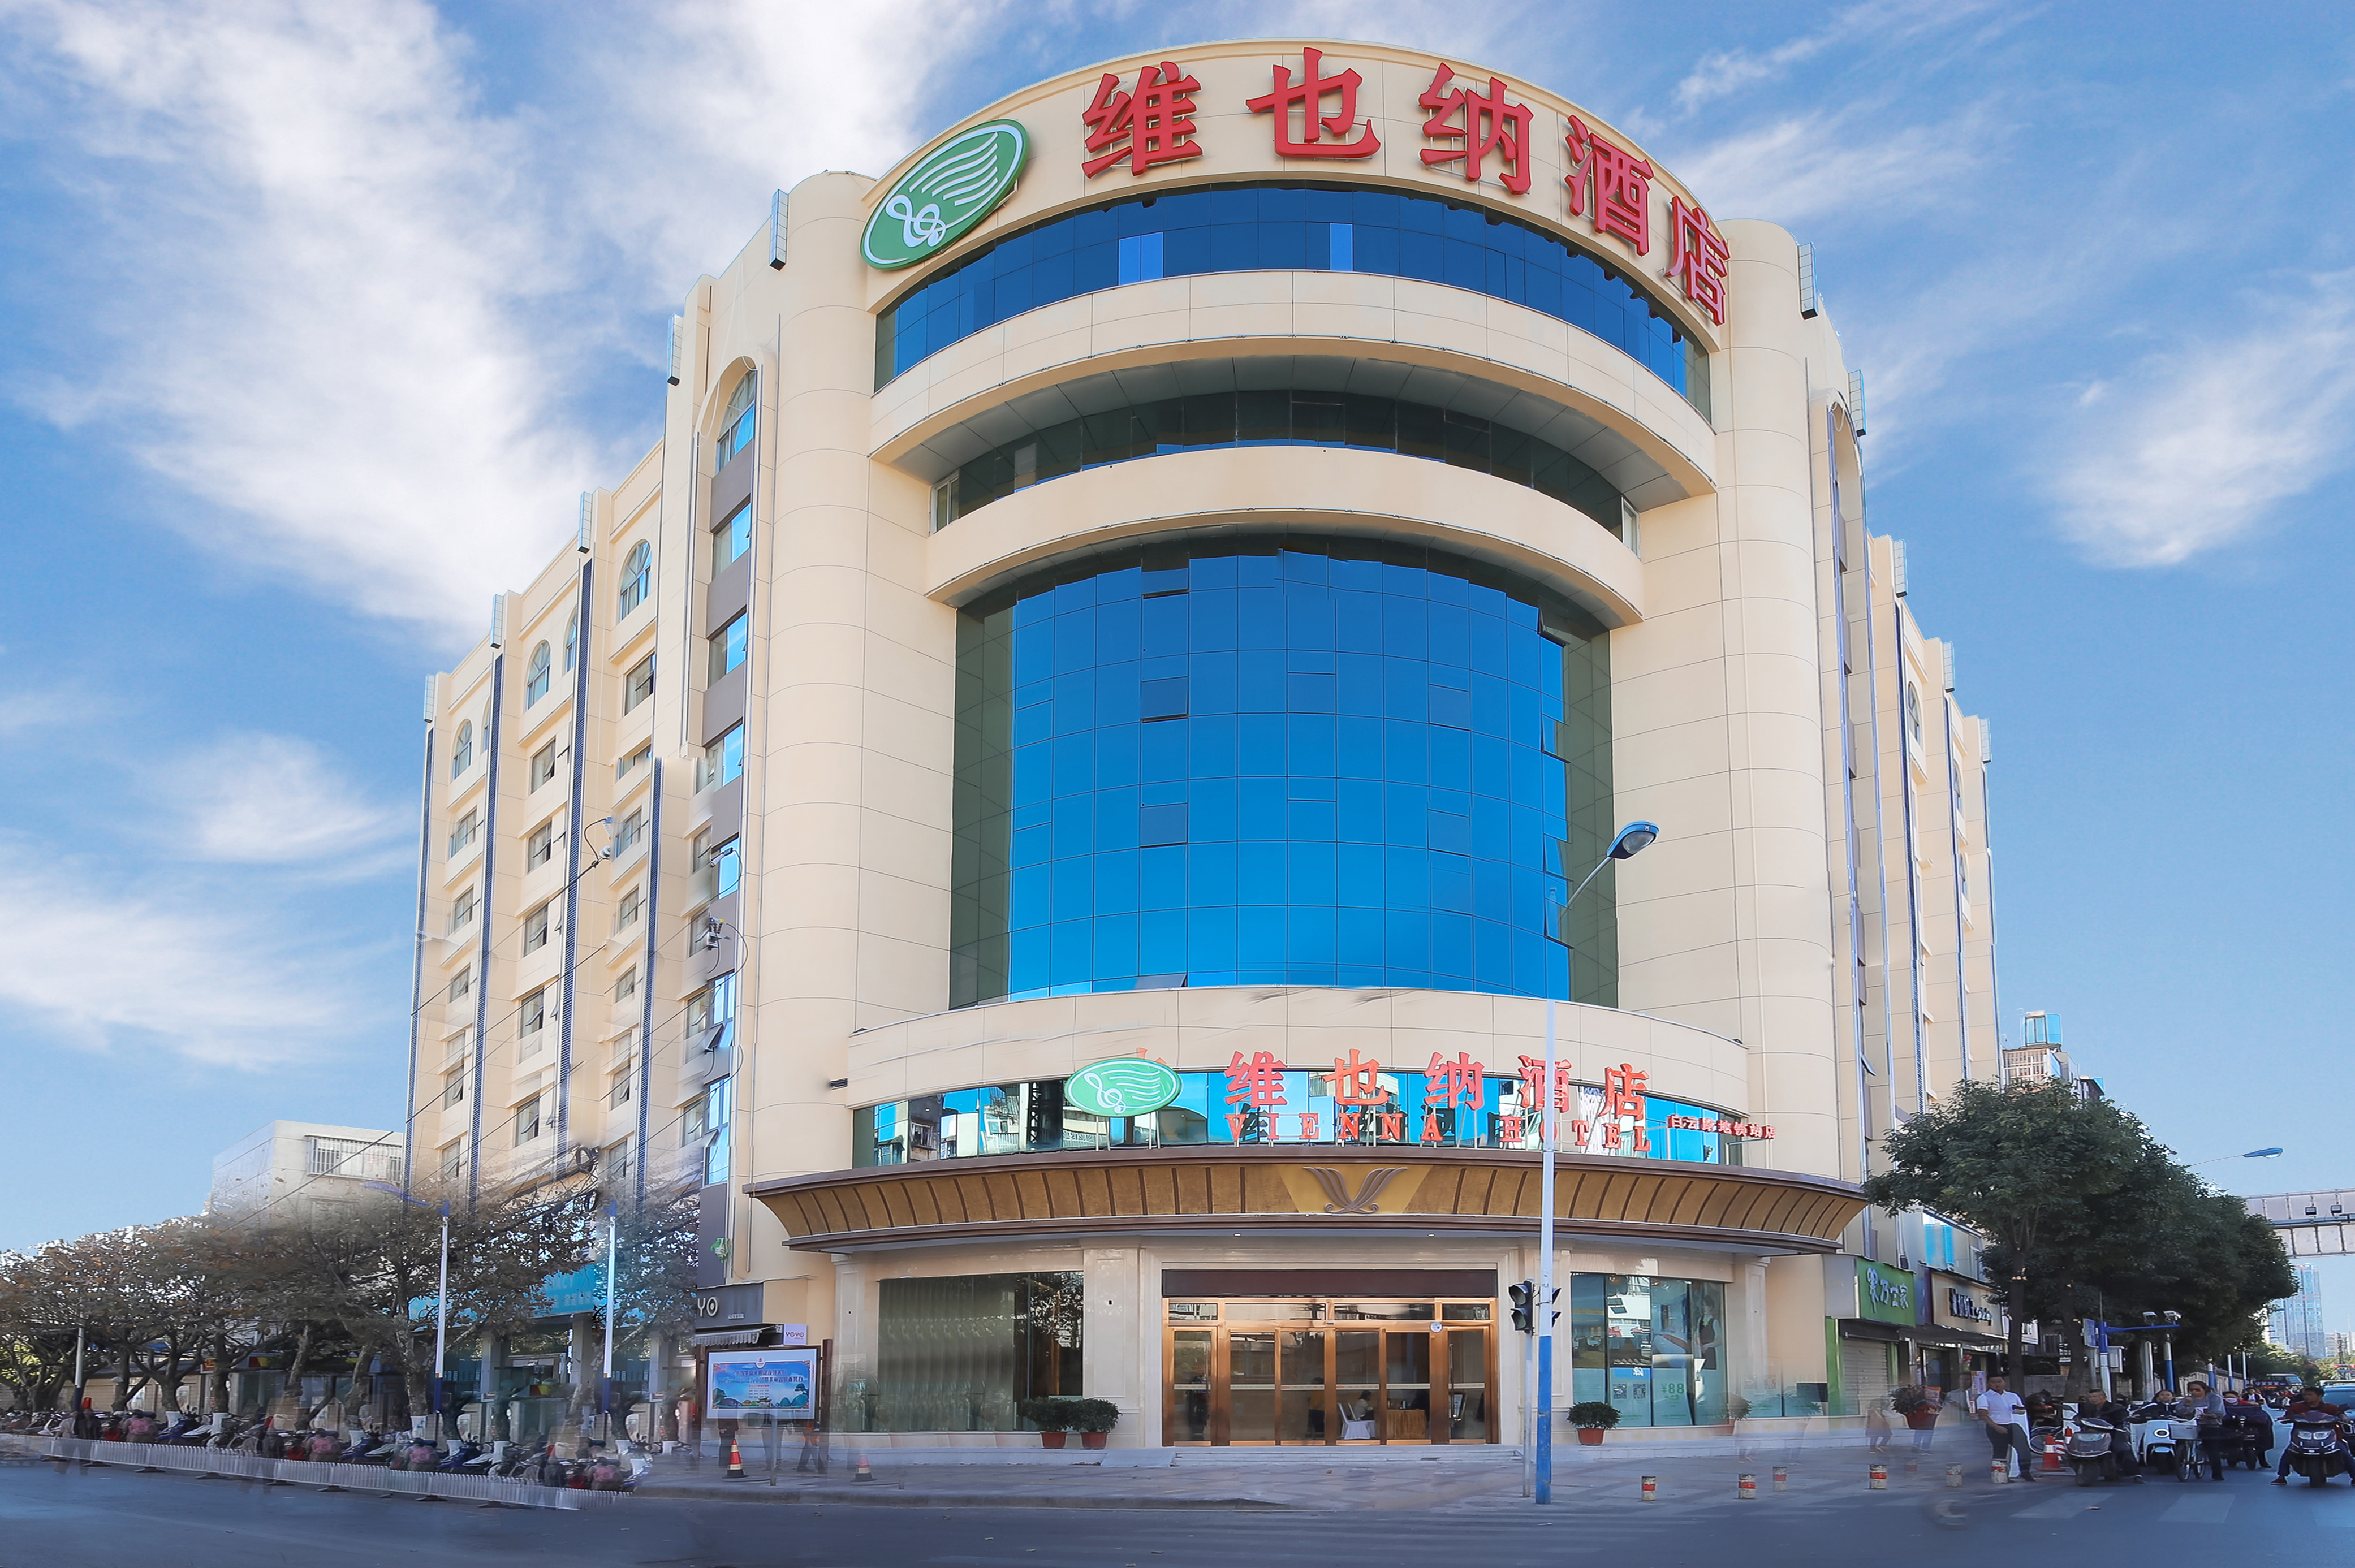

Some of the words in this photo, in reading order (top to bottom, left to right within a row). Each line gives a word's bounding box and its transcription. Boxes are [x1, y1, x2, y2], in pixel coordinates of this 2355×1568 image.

[1081, 46, 1731, 327] 维也纳酒店
[1224, 1048, 1650, 1121] 维也纳酒店
[1225, 1112, 1444, 1142] VIENNA
[1668, 1114, 1775, 1139] 白云路地铁站店
